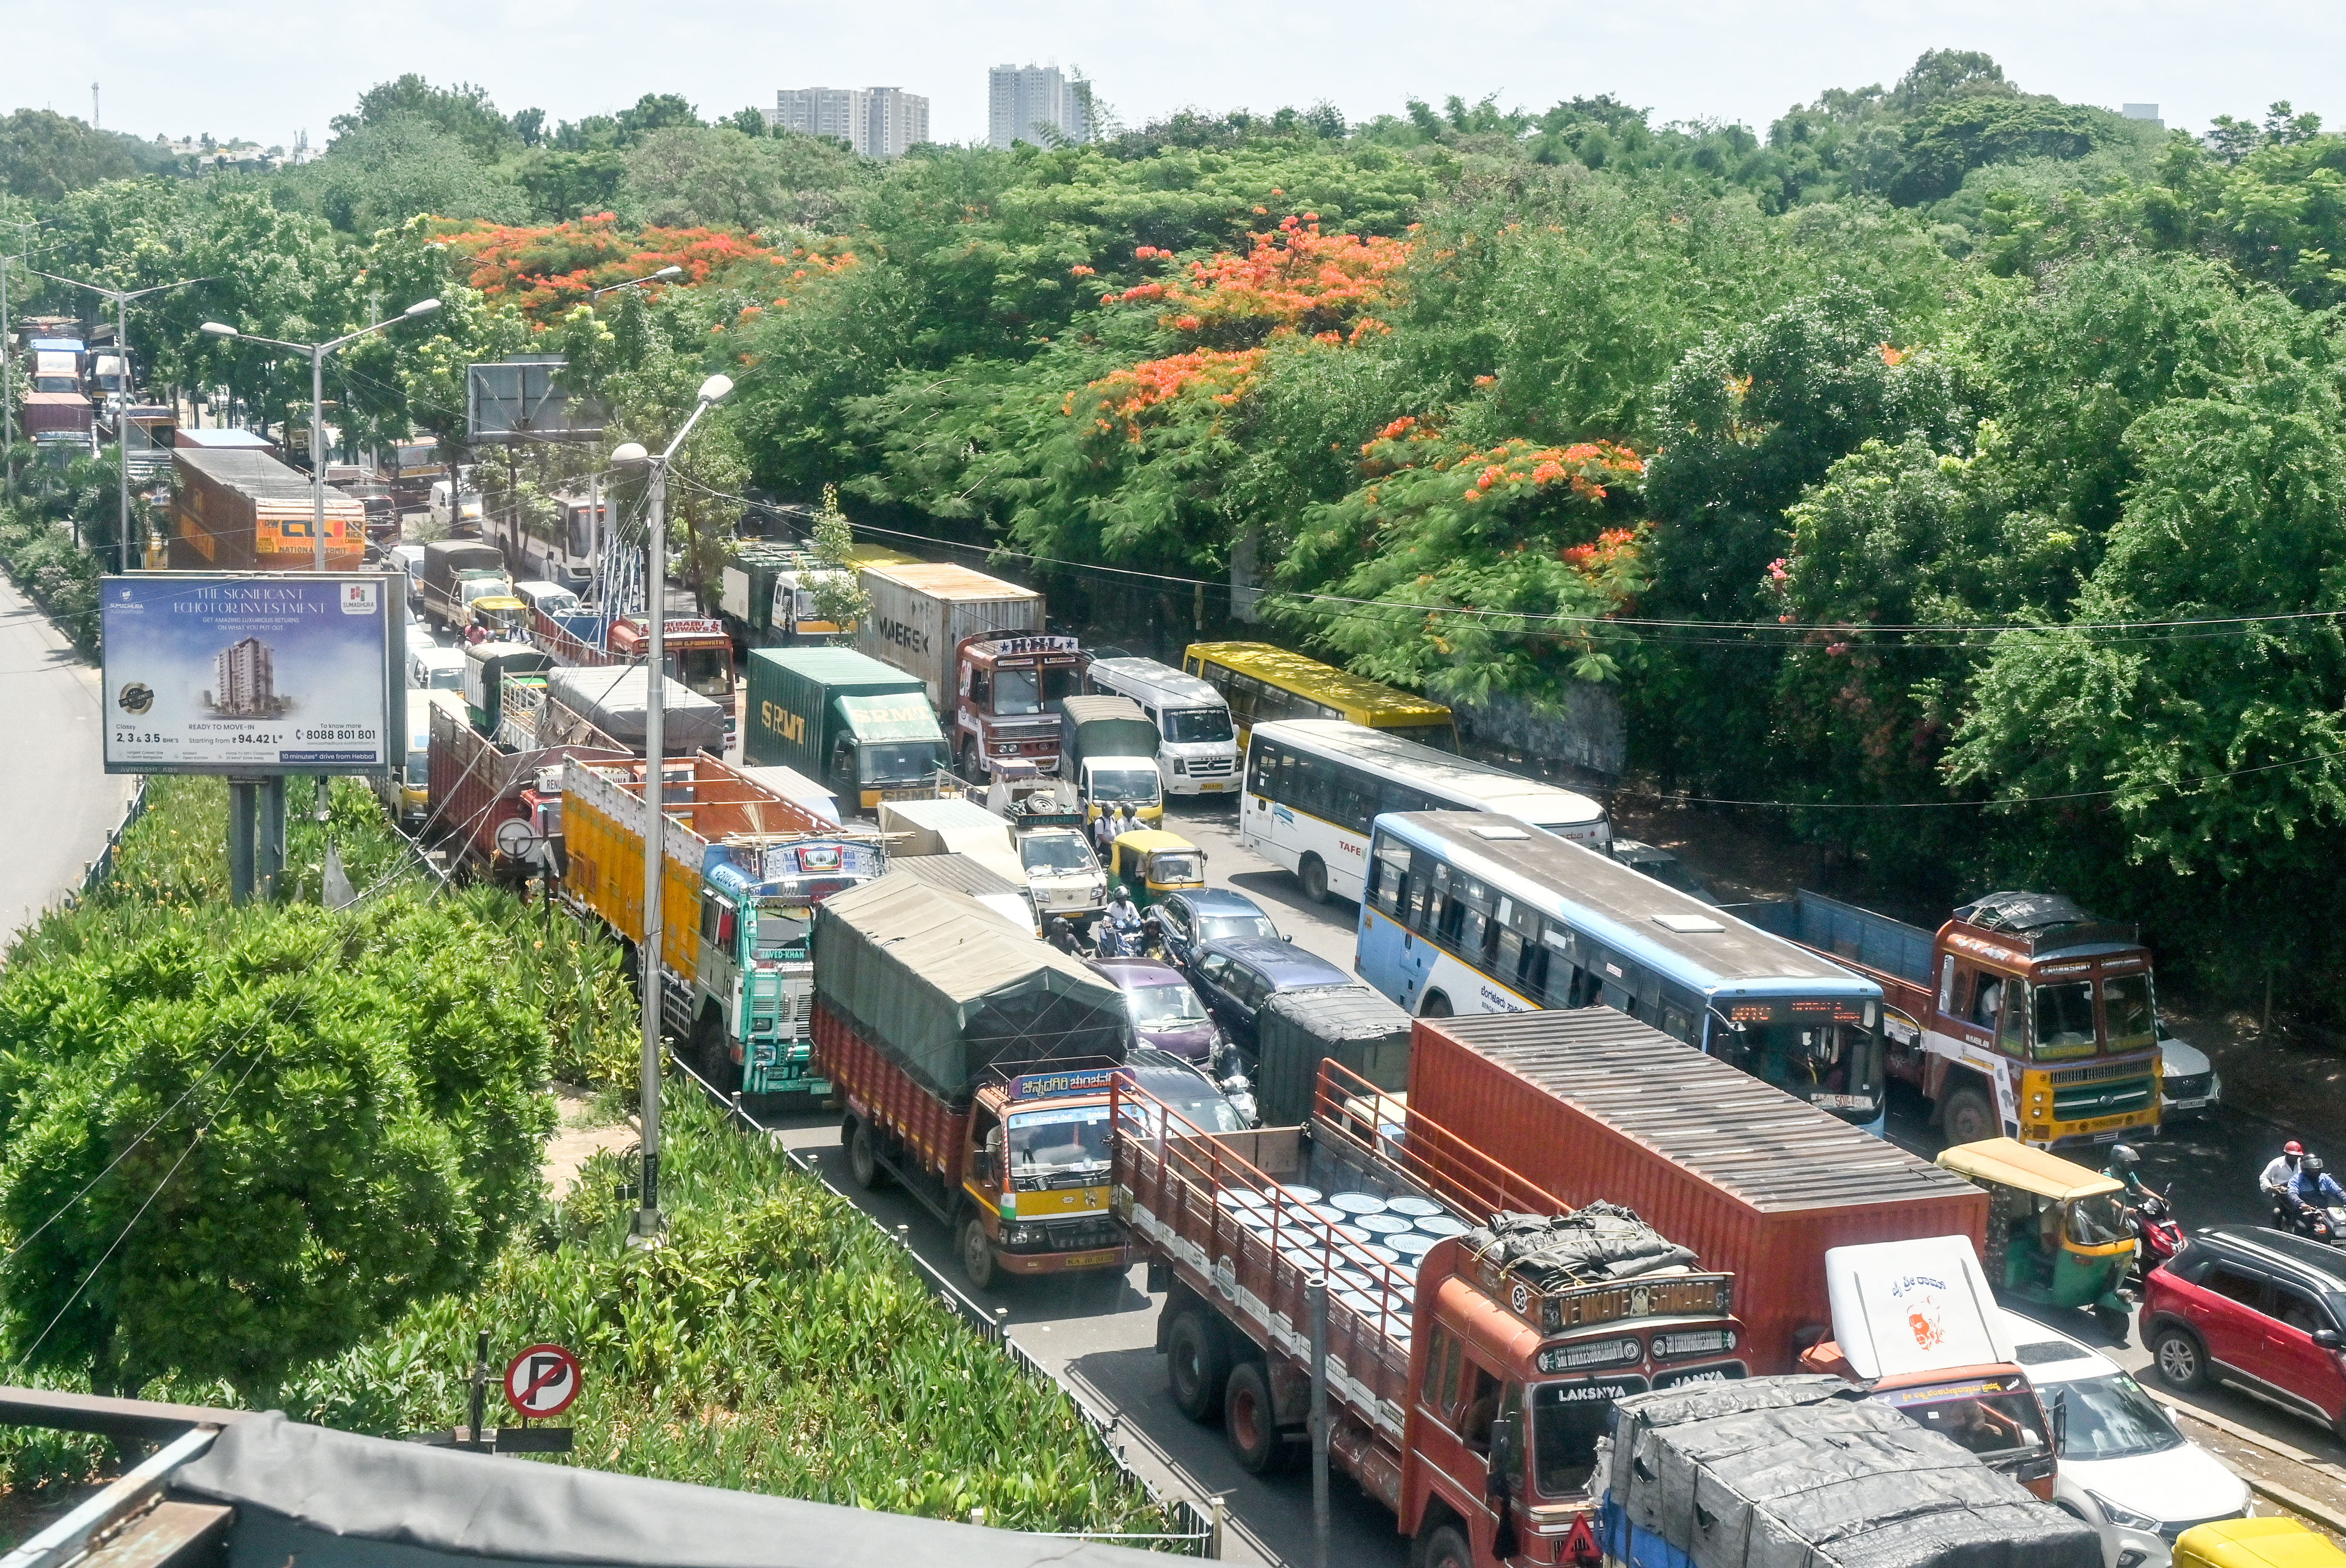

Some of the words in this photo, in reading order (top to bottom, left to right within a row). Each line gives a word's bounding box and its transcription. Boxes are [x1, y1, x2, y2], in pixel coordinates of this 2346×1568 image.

[198, 588, 221, 599] THE
[224, 588, 306, 599] SIGNIFICANT
[211, 602, 237, 613] FOR
[241, 602, 327, 614] INVESTMENT
[879, 617, 930, 658] MAERSK
[852, 706, 930, 723] SRMT
[761, 700, 805, 745] SRMT
[116, 733, 125, 743] 2,
[127, 733, 134, 742] 3
[144, 733, 160, 743] 3.5
[238, 734, 270, 744] 94.42
[307, 730, 334, 739] 8088
[337, 730, 355, 739] 801
[358, 730, 375, 739] 801
[1339, 840, 1361, 856] TAFE
[1903, 1276, 1915, 1292] ಶ್ರೀ
[1917, 1276, 1946, 1290] ರಾಮ್
